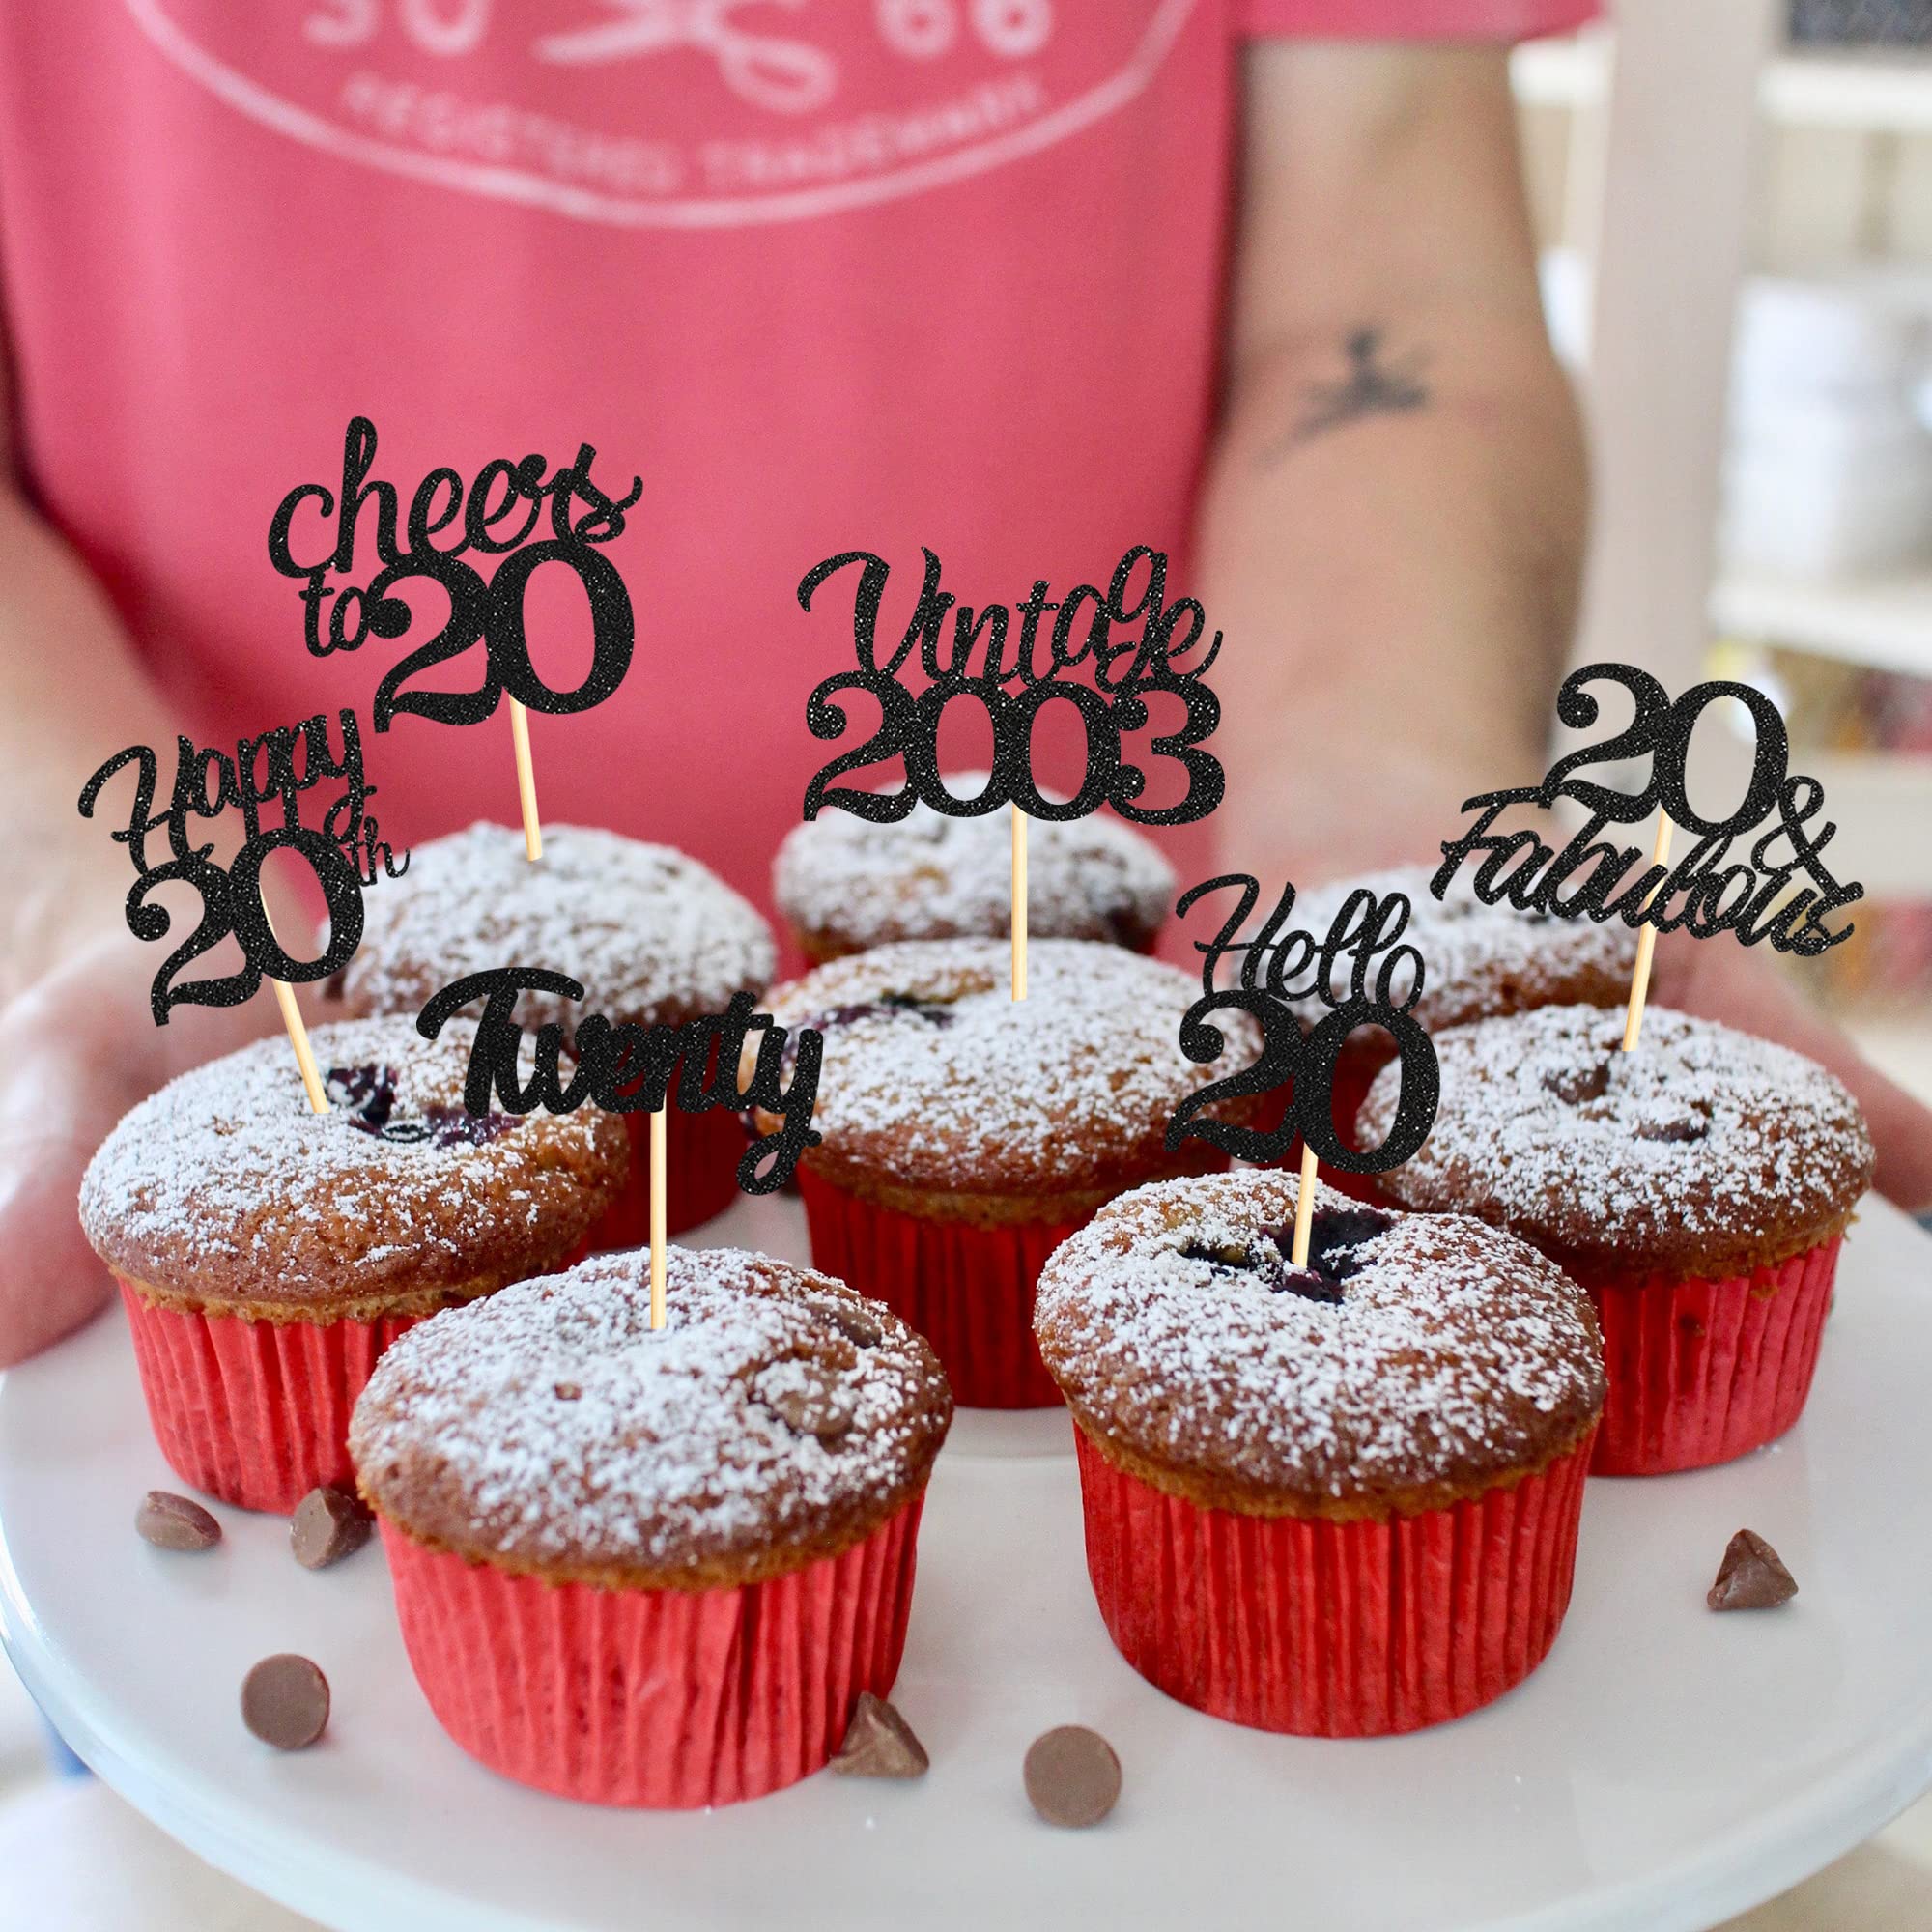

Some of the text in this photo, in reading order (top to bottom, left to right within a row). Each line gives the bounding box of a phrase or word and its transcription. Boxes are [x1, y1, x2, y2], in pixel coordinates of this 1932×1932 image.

[268, 416, 644, 579] cheers
[299, 539, 635, 733] to 20
[797, 545, 1223, 694] Vintage
[78, 708, 378, 875] Happy
[803, 670, 1226, 826] 2003
[1176, 873, 1425, 1014] Hello
[1430, 786, 1864, 956] Fabulous
[416, 967, 823, 1195] Twenty
[1165, 989, 1440, 1175] 20
